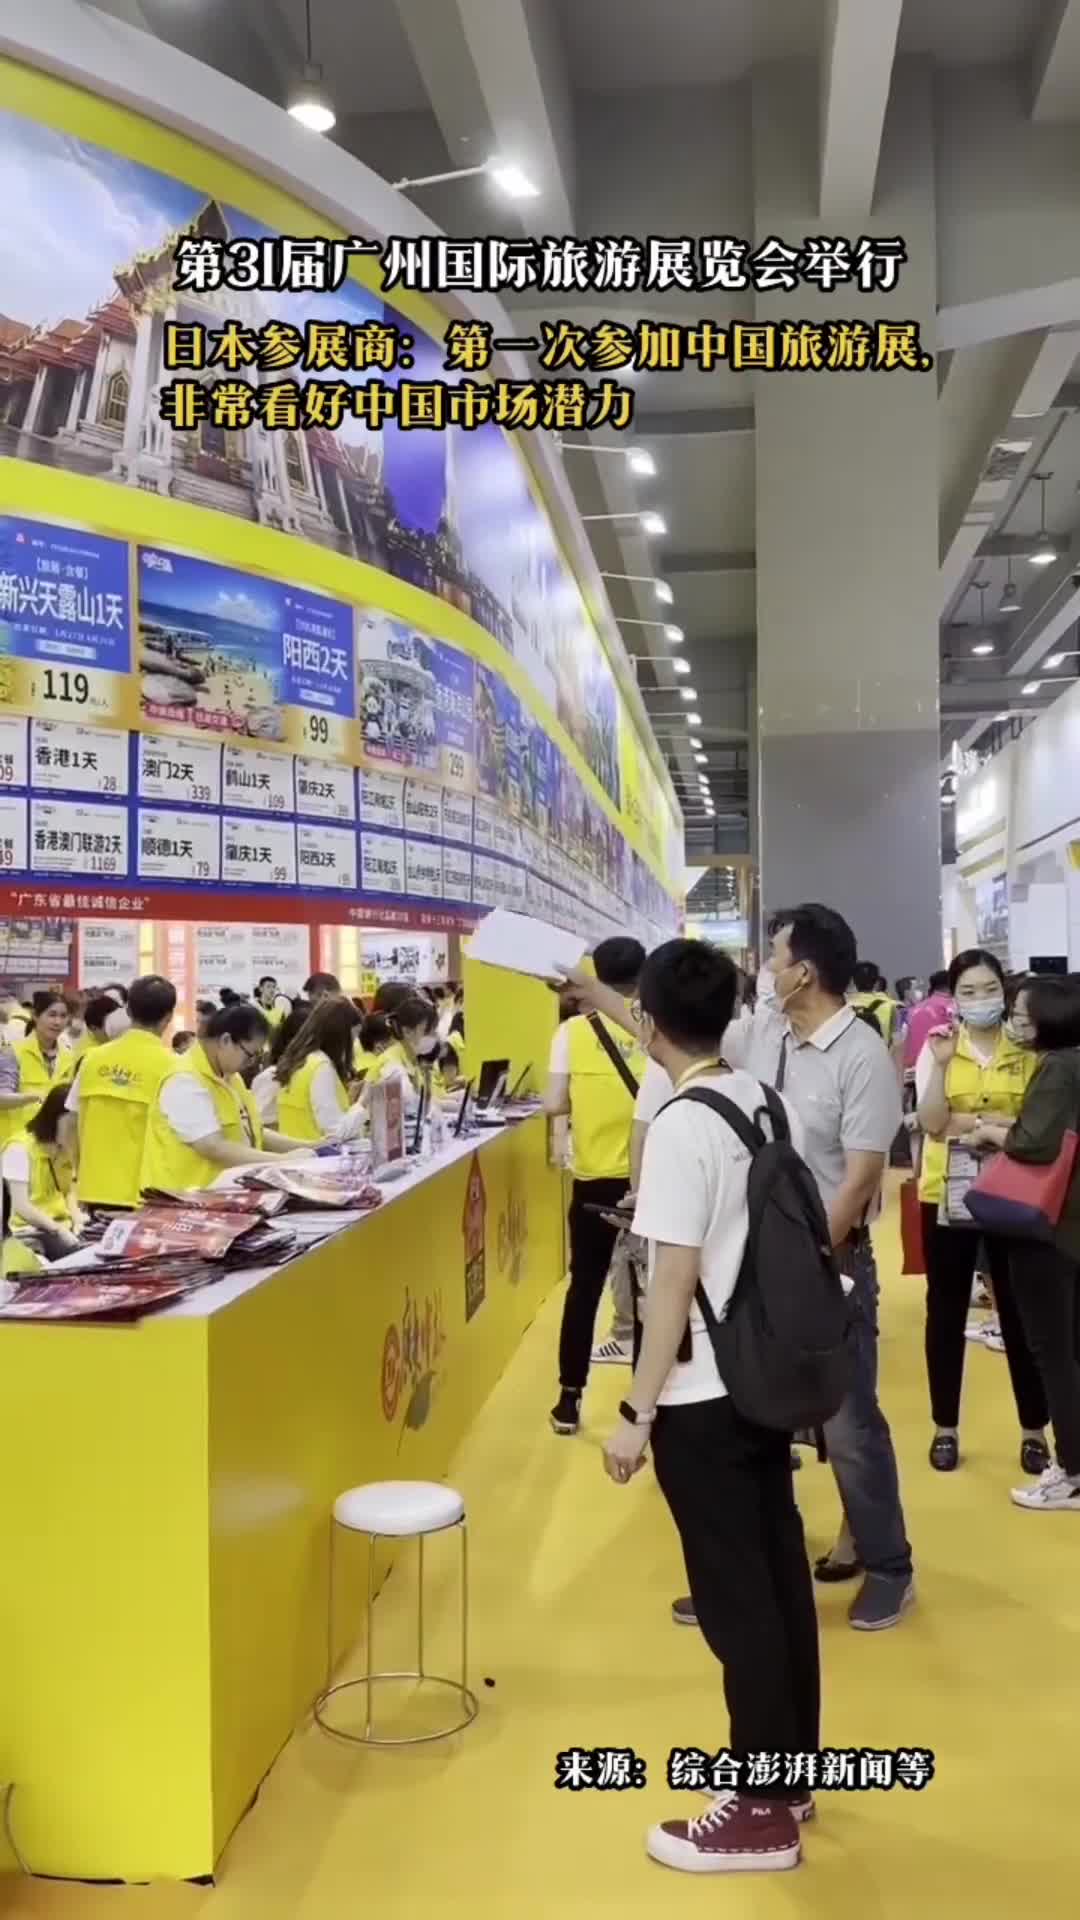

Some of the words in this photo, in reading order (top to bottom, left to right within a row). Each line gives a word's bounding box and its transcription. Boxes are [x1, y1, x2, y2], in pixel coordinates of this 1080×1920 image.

[0, 571, 124, 630] 新兴天露山1天
[283, 632, 348, 680] 阳西2天
[43, 669, 89, 705] 119
[310, 715, 328, 743] 99
[35, 746, 98, 771] 香港1天
[142, 759, 195, 782] 澳门2天
[103, 775, 117, 792] 28
[191, 784, 211, 801] 339
[298, 779, 337, 799] 肇庆2天
[34, 829, 122, 854] 香港澳门联游2天
[142, 838, 193, 858] 顺德1天
[225, 844, 273, 863] 肇庆1天
[196, 862, 210, 877] 79
